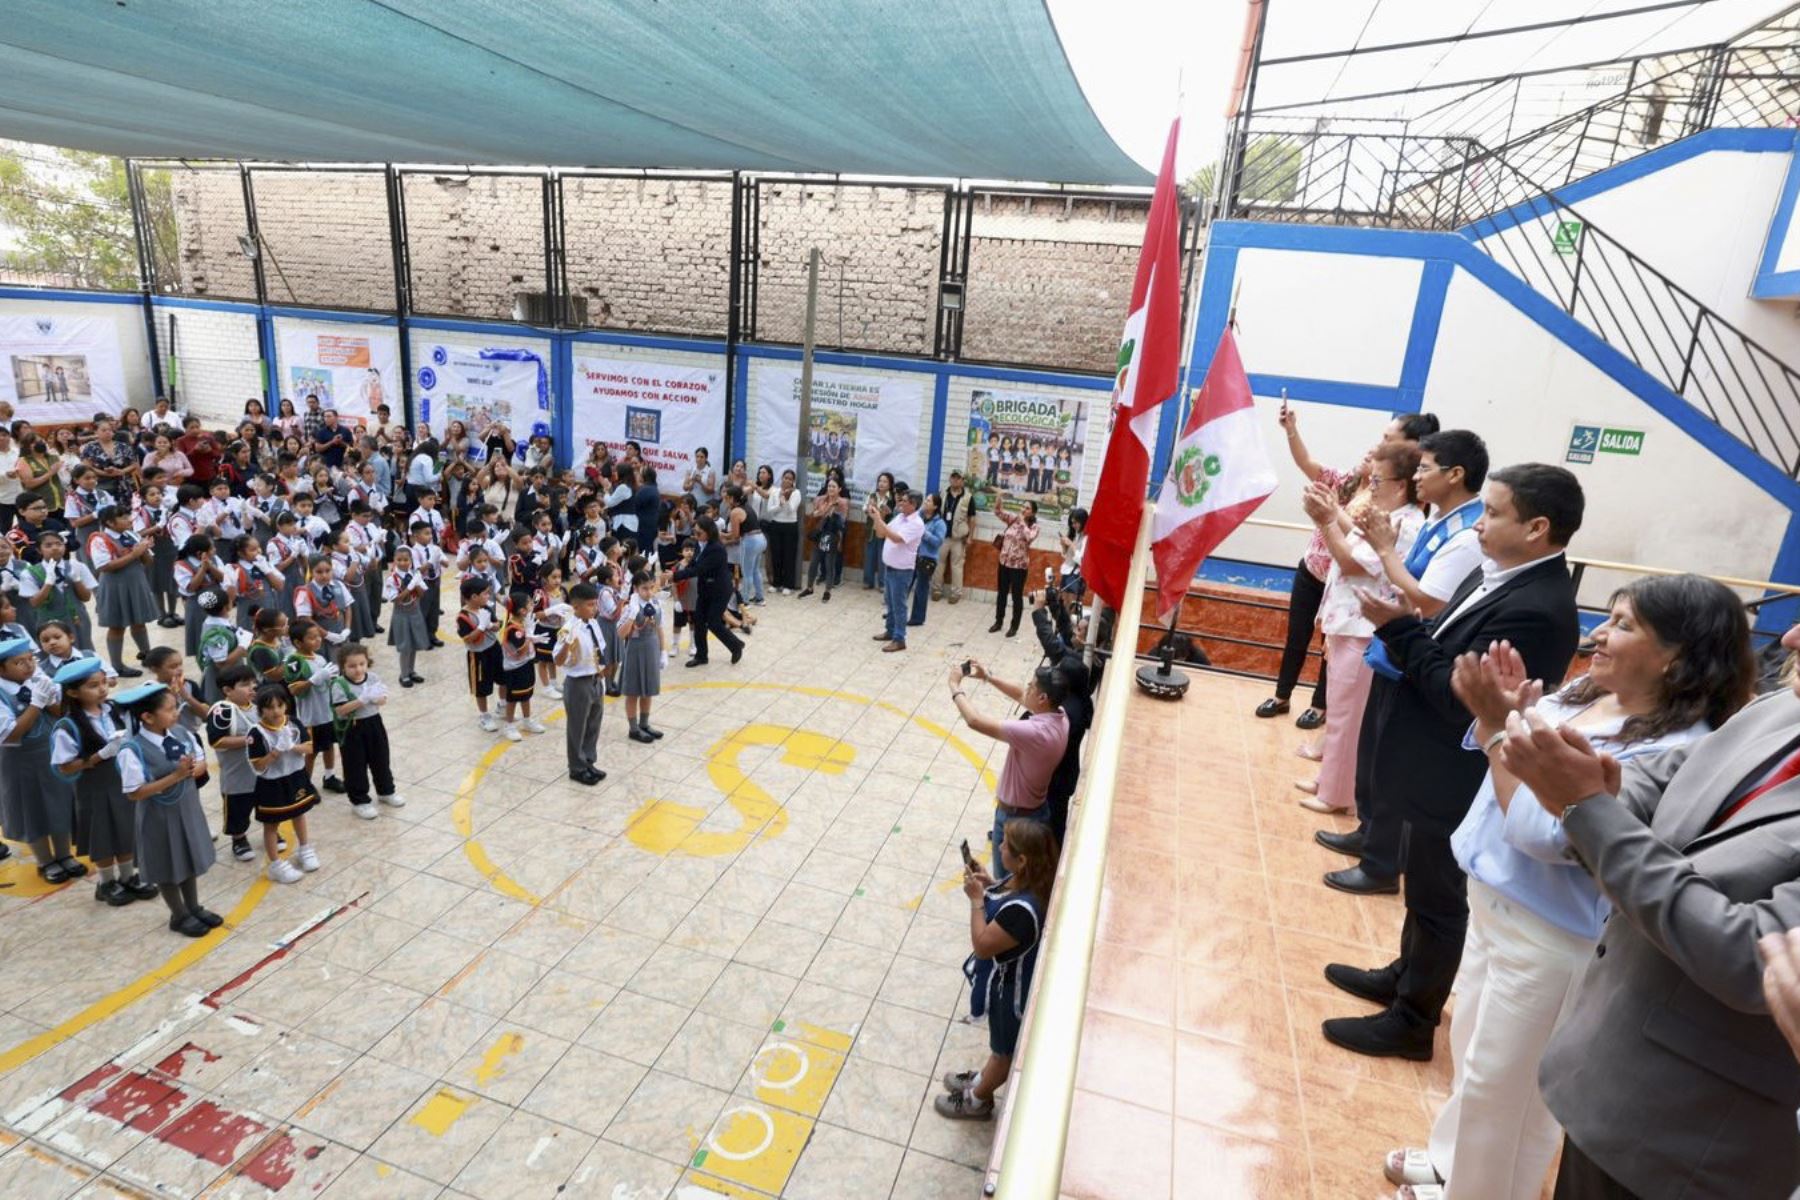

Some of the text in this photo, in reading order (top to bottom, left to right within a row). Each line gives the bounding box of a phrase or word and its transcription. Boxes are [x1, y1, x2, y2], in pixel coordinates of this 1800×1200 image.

[586, 371, 629, 384] SERVIMOS
[631, 376, 649, 386] CON
[652, 379, 661, 387] EL
[593, 386, 638, 398] AYUDAMOS
[642, 391, 660, 401] CON
[850, 400, 879, 409] HOGAR
[996, 400, 1057, 418] BRIGADA
[1602, 433, 1640, 450] SALIDA
[642, 447, 660, 457] QUE
[662, 449, 689, 461] SALVA
